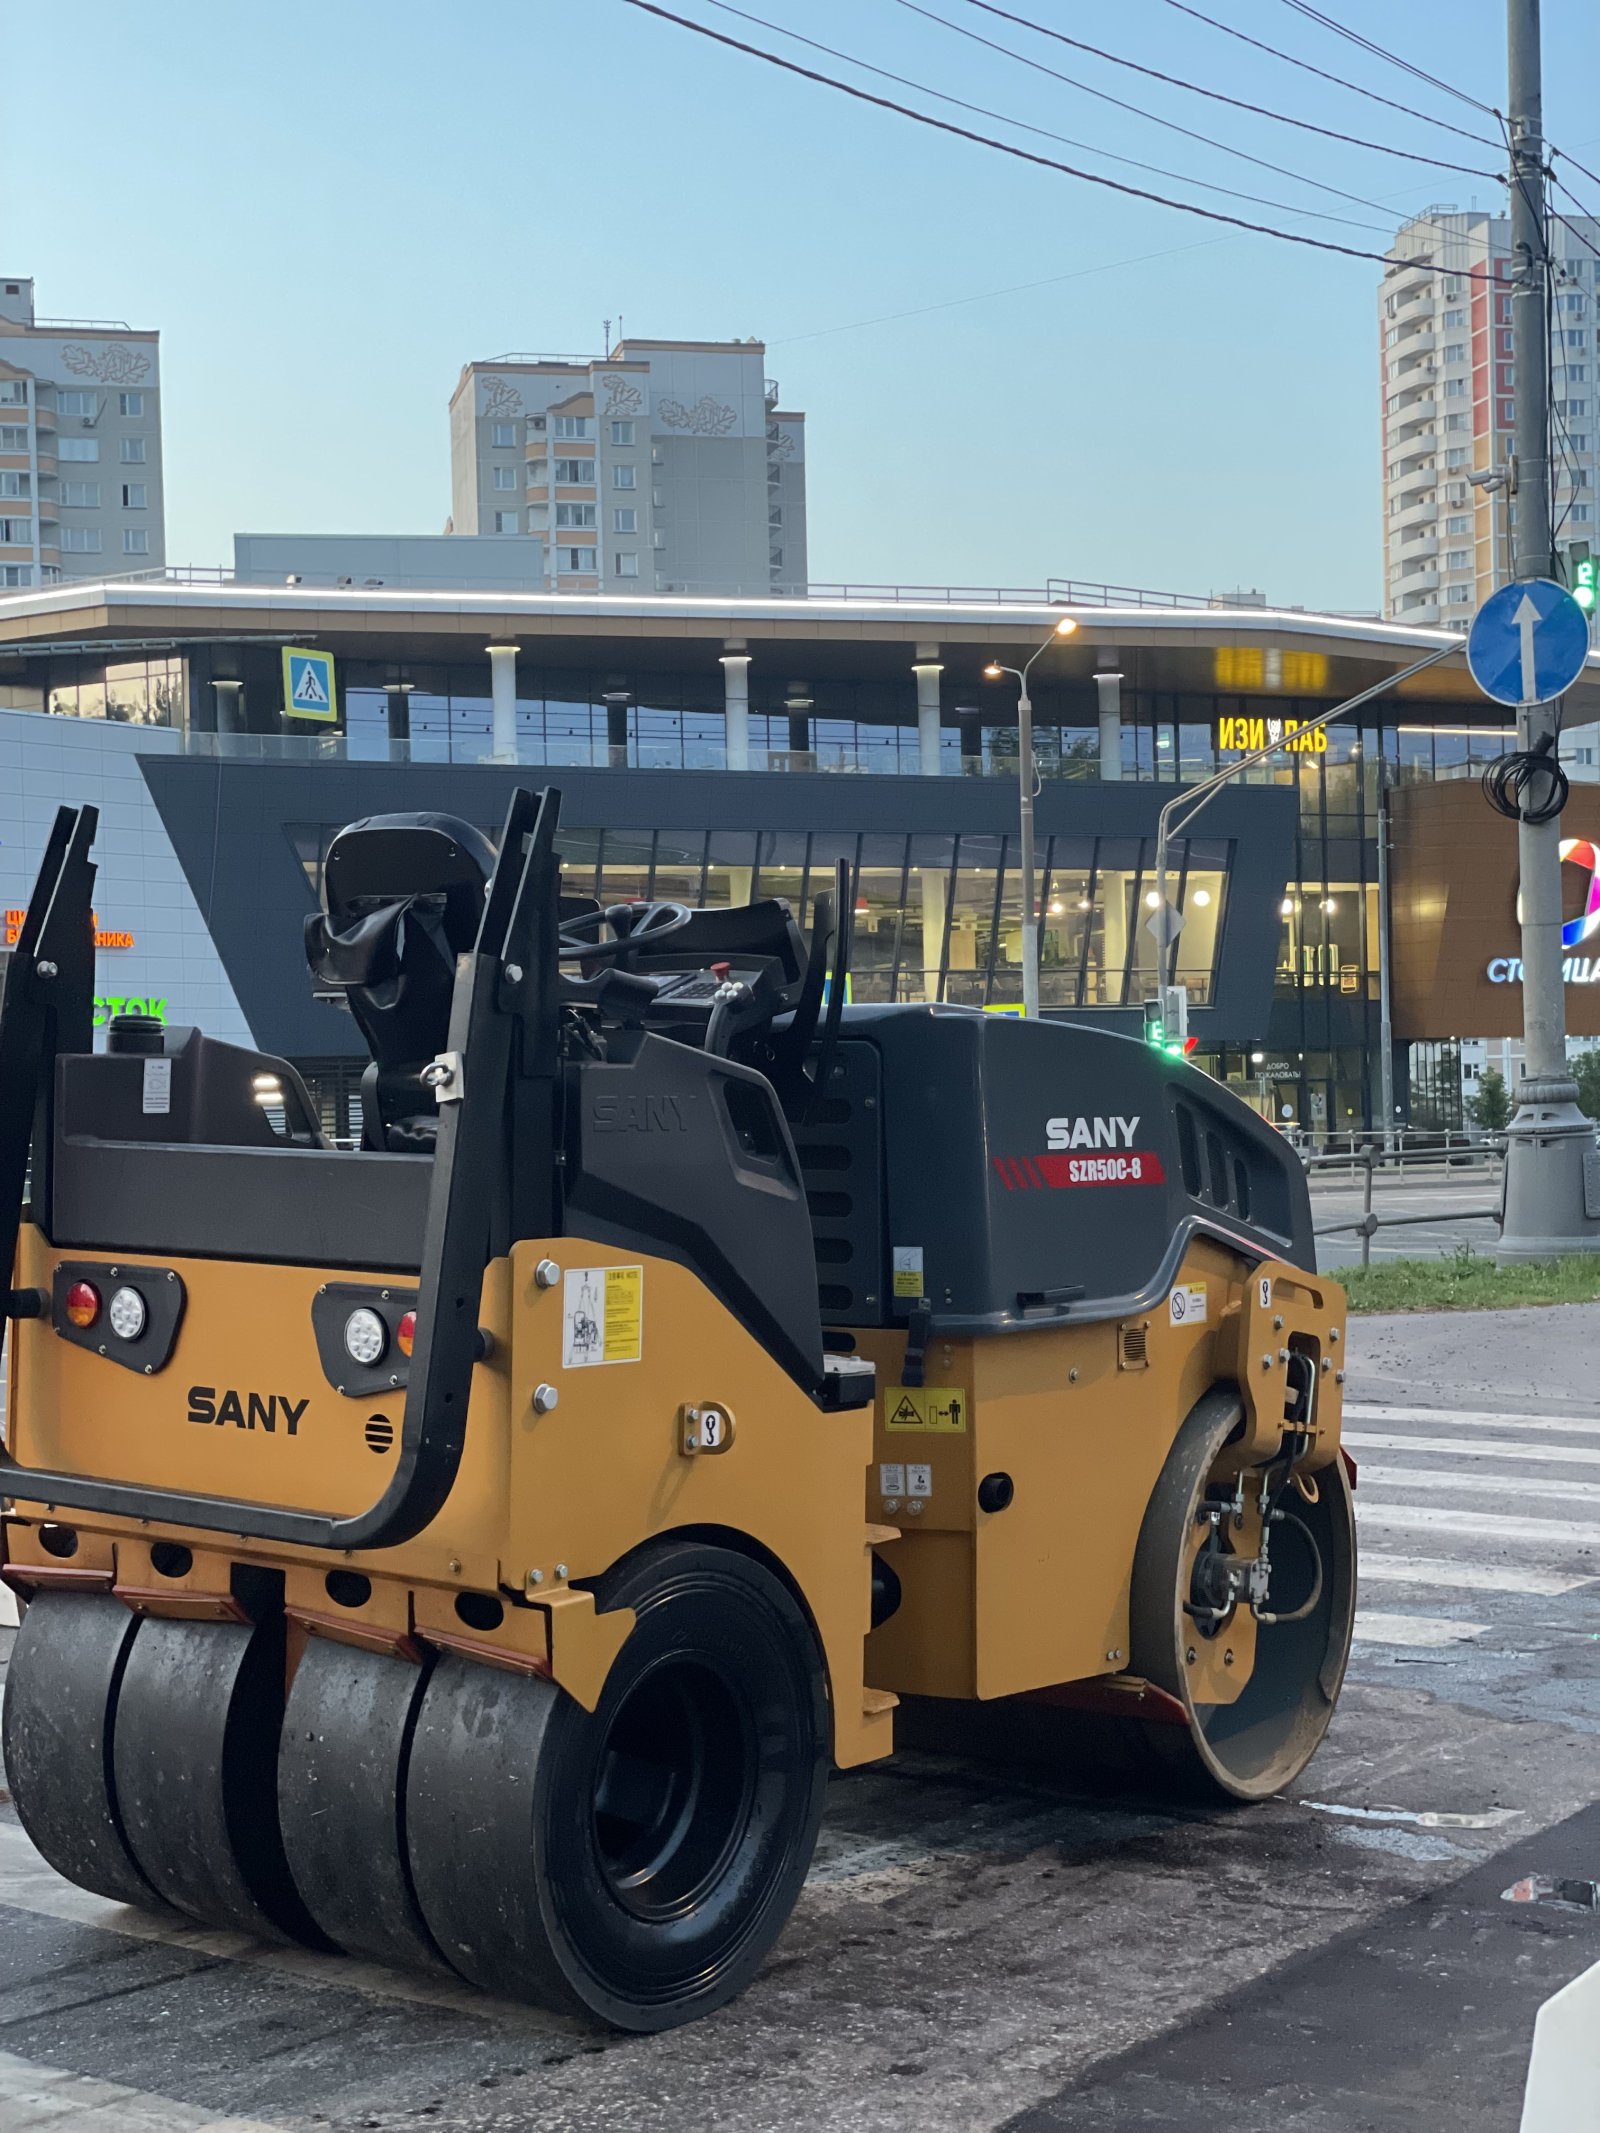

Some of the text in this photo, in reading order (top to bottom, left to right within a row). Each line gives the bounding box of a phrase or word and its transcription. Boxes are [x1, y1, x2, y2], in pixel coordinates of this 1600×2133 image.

[1220, 717, 1327, 752] ИЗИ ПАБ
[95, 931, 134, 946] НИКА
[1487, 957, 1600, 983] СТИЦ
[593, 1096, 697, 1132] SANY
[1046, 1117, 1140, 1149] SANY
[1069, 1157, 1142, 1182] SZR50C-8
[188, 1386, 310, 1435] SANY
